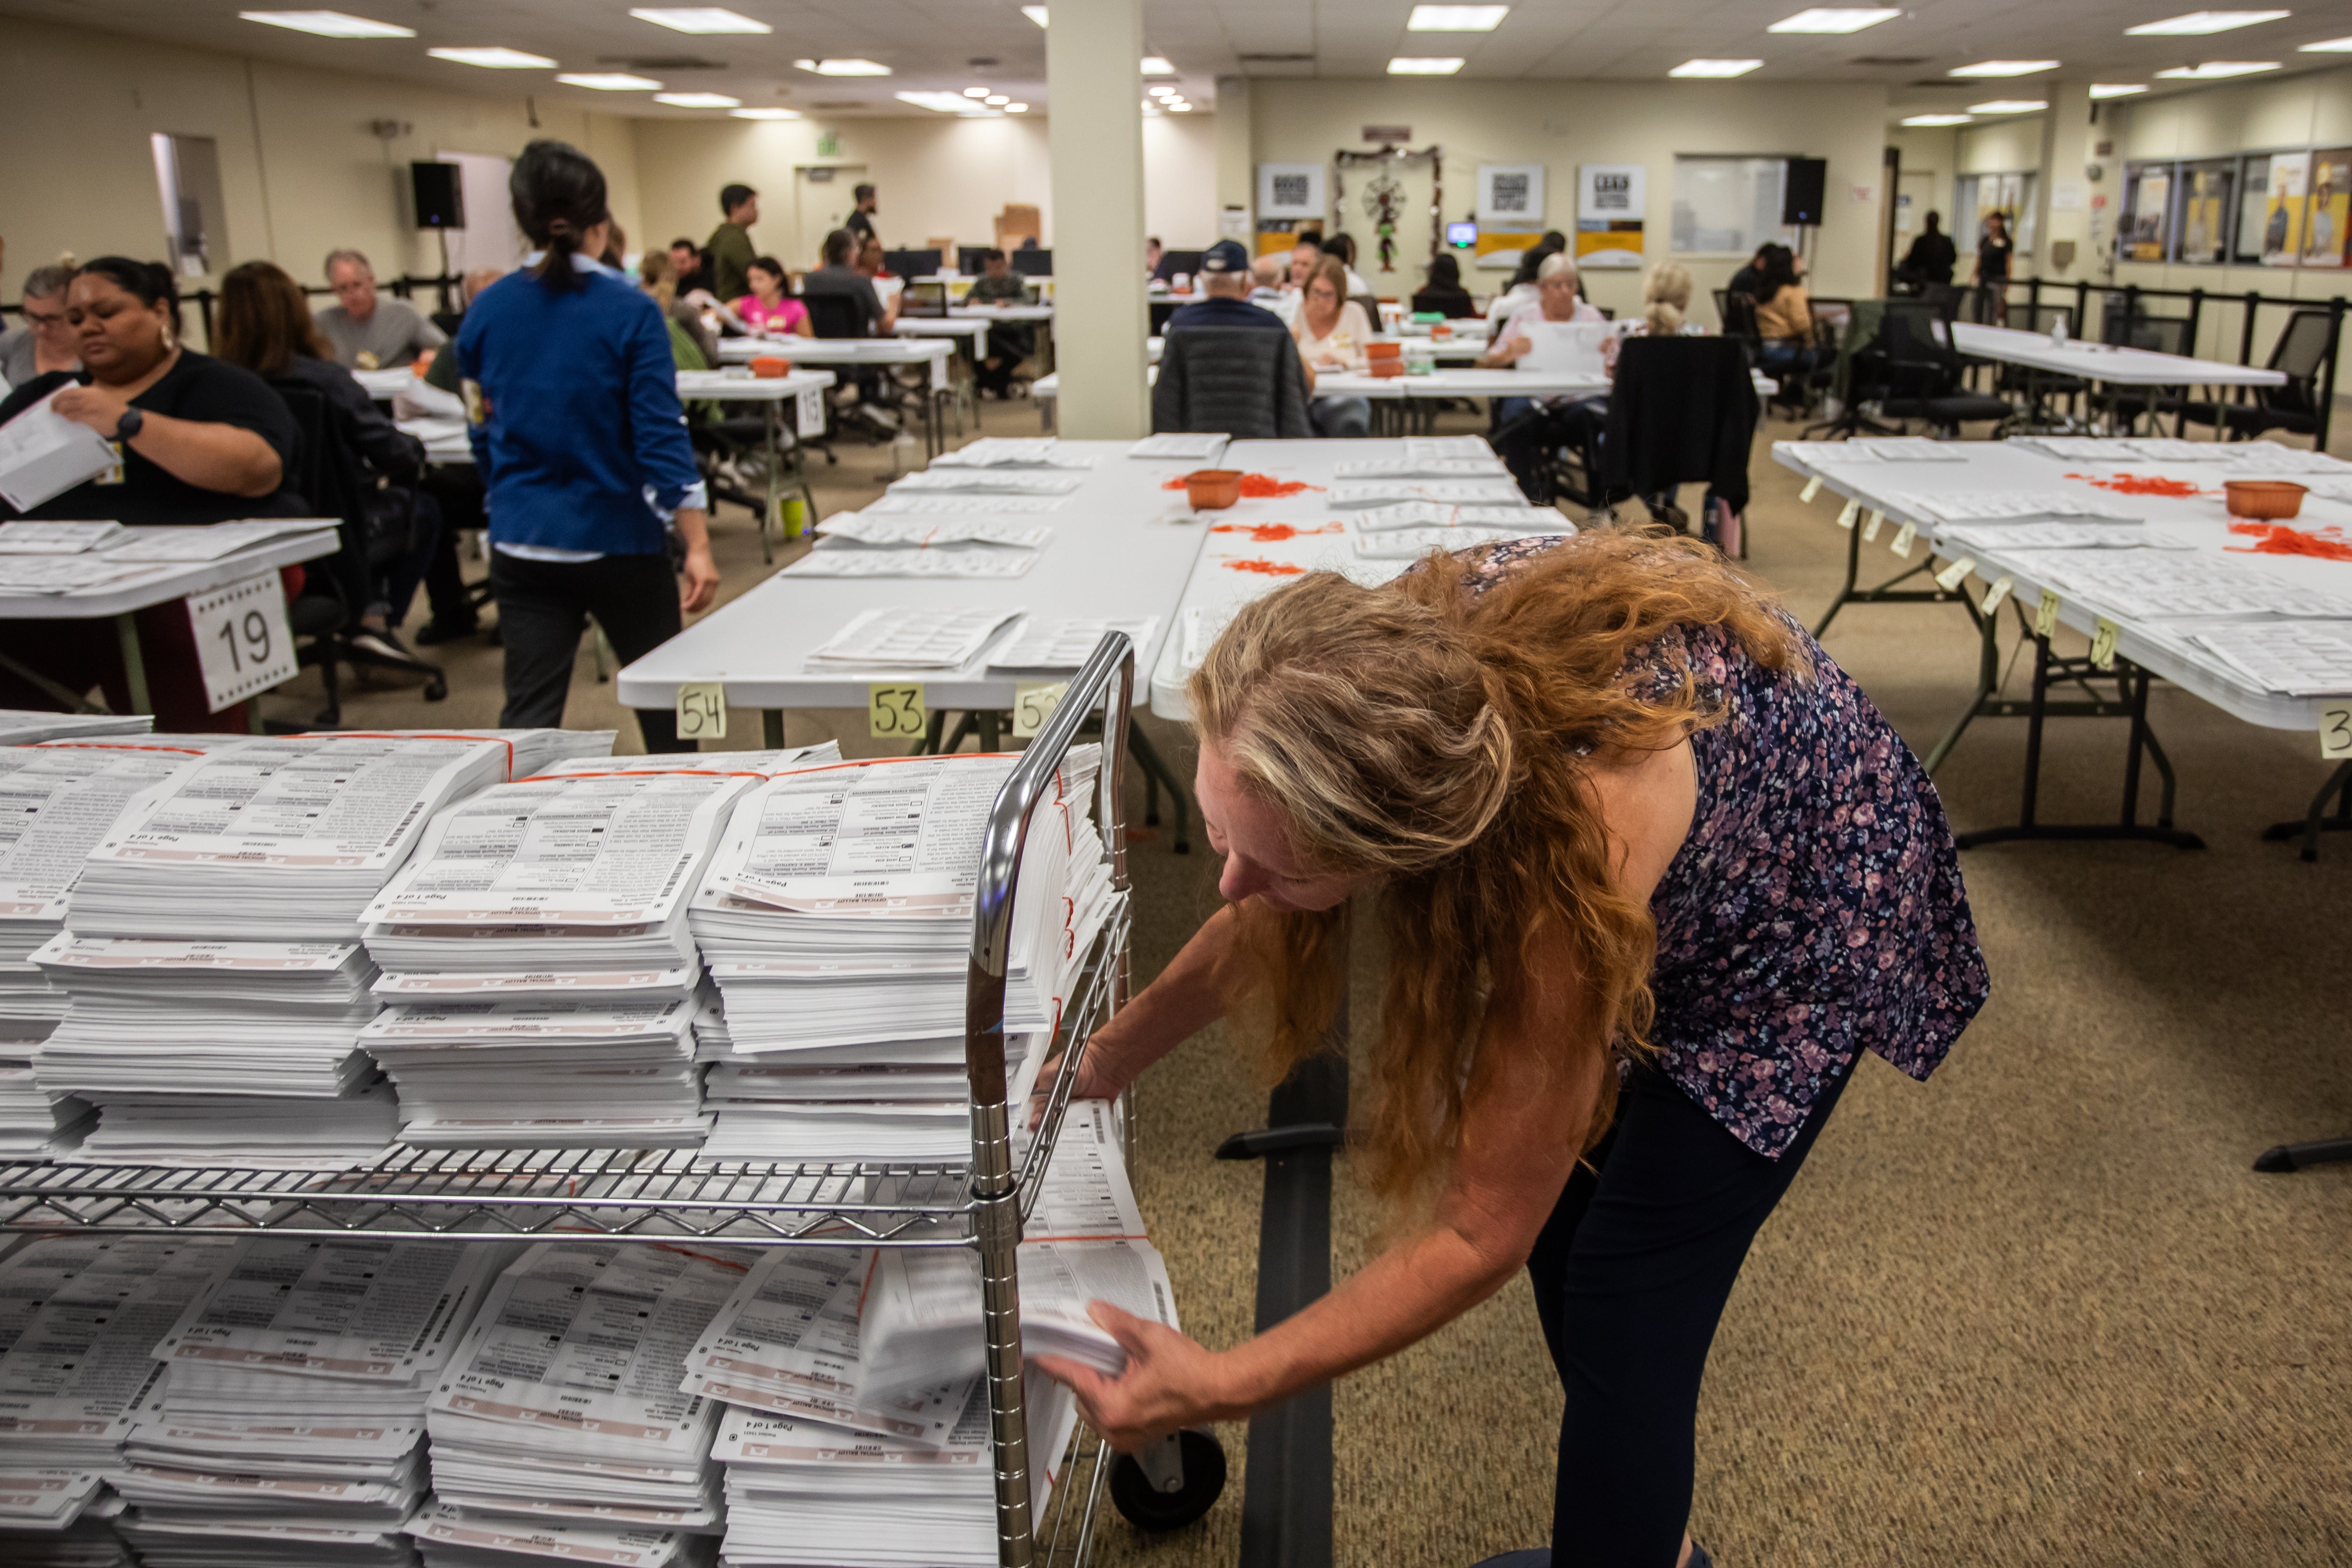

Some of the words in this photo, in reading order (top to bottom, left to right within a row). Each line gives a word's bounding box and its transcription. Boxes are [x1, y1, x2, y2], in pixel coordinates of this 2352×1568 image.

[218, 610, 270, 673] 19
[682, 691, 720, 734] 54
[875, 689, 922, 734] 53
[741, 1343, 759, 1351] Page
[485, 1379, 504, 1389] Page
[773, 1422, 792, 1432] Page
